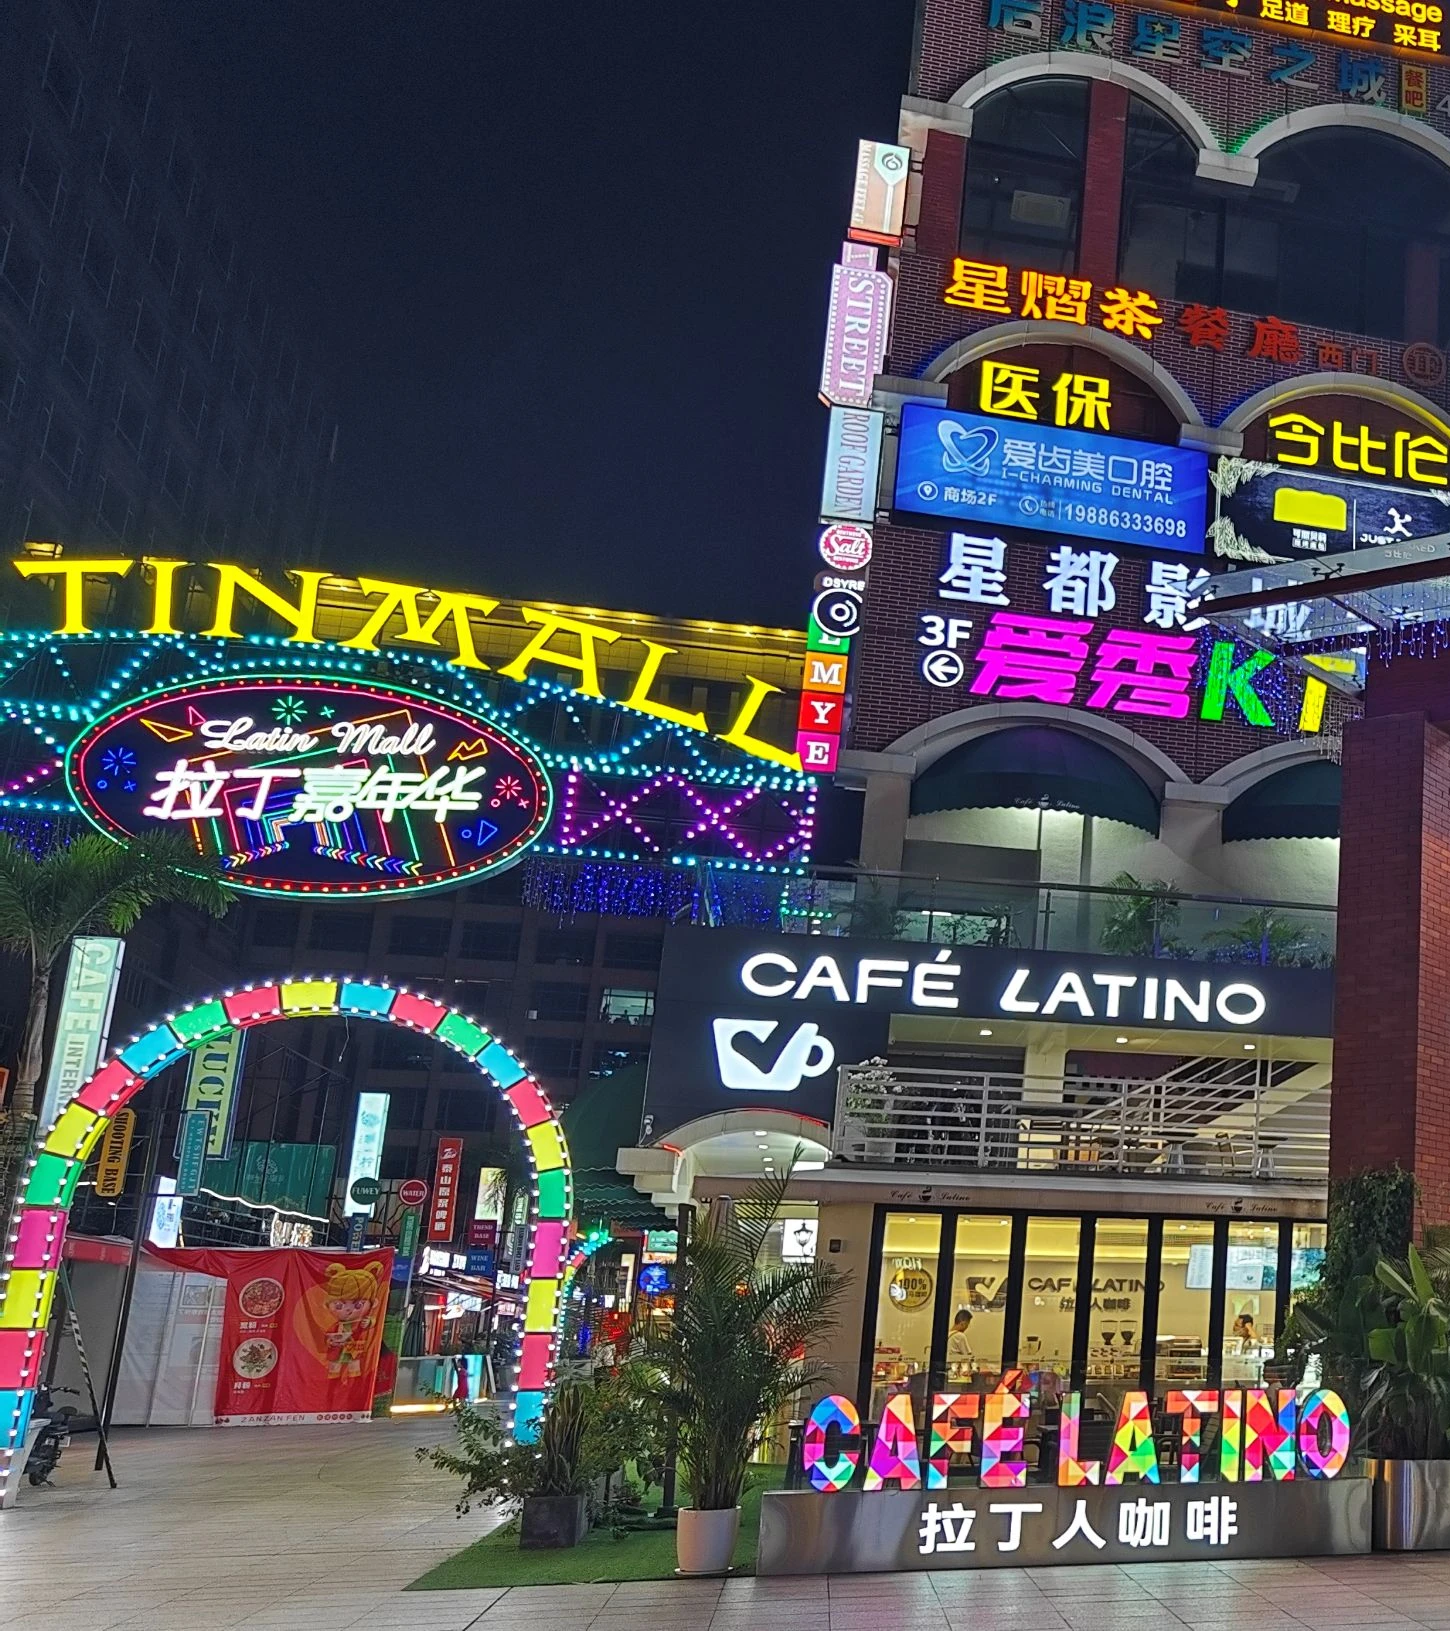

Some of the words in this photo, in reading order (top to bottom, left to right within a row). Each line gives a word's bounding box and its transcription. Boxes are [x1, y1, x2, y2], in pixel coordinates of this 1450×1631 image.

[1327, 10, 1376, 38] 理疗
[1393, 23, 1441, 52] 采耳
[839, 279, 875, 396] STREET
[980, 360, 1111, 431] 医保
[841, 412, 871, 453] ROOF
[834, 455, 867, 516] GARDEN
[1002, 437, 1173, 493] 爱齿美口腔
[1065, 503, 1187, 538] 19886333698
[1111, 484, 1174, 506] DENTAL
[918, 614, 973, 649] 3F
[201, 716, 319, 752] Latin
[330, 721, 437, 757] Mall
[143, 758, 487, 823] 拉丁嘉年华
[64, 942, 112, 1032] CAFE
[741, 950, 962, 1009] CAFÉ
[999, 968, 1267, 1025] LATINO
[107, 1111, 129, 1163] SHOOTING
[101, 1168, 119, 1194] BASE
[350, 1215, 365, 1252] POWE
[1028, 1277, 1077, 1292] CAF
[803, 1369, 1031, 1493] CAFÉ
[1057, 1388, 1353, 1487] LATINO
[919, 1496, 1239, 1554] 拉丁人咖啡
